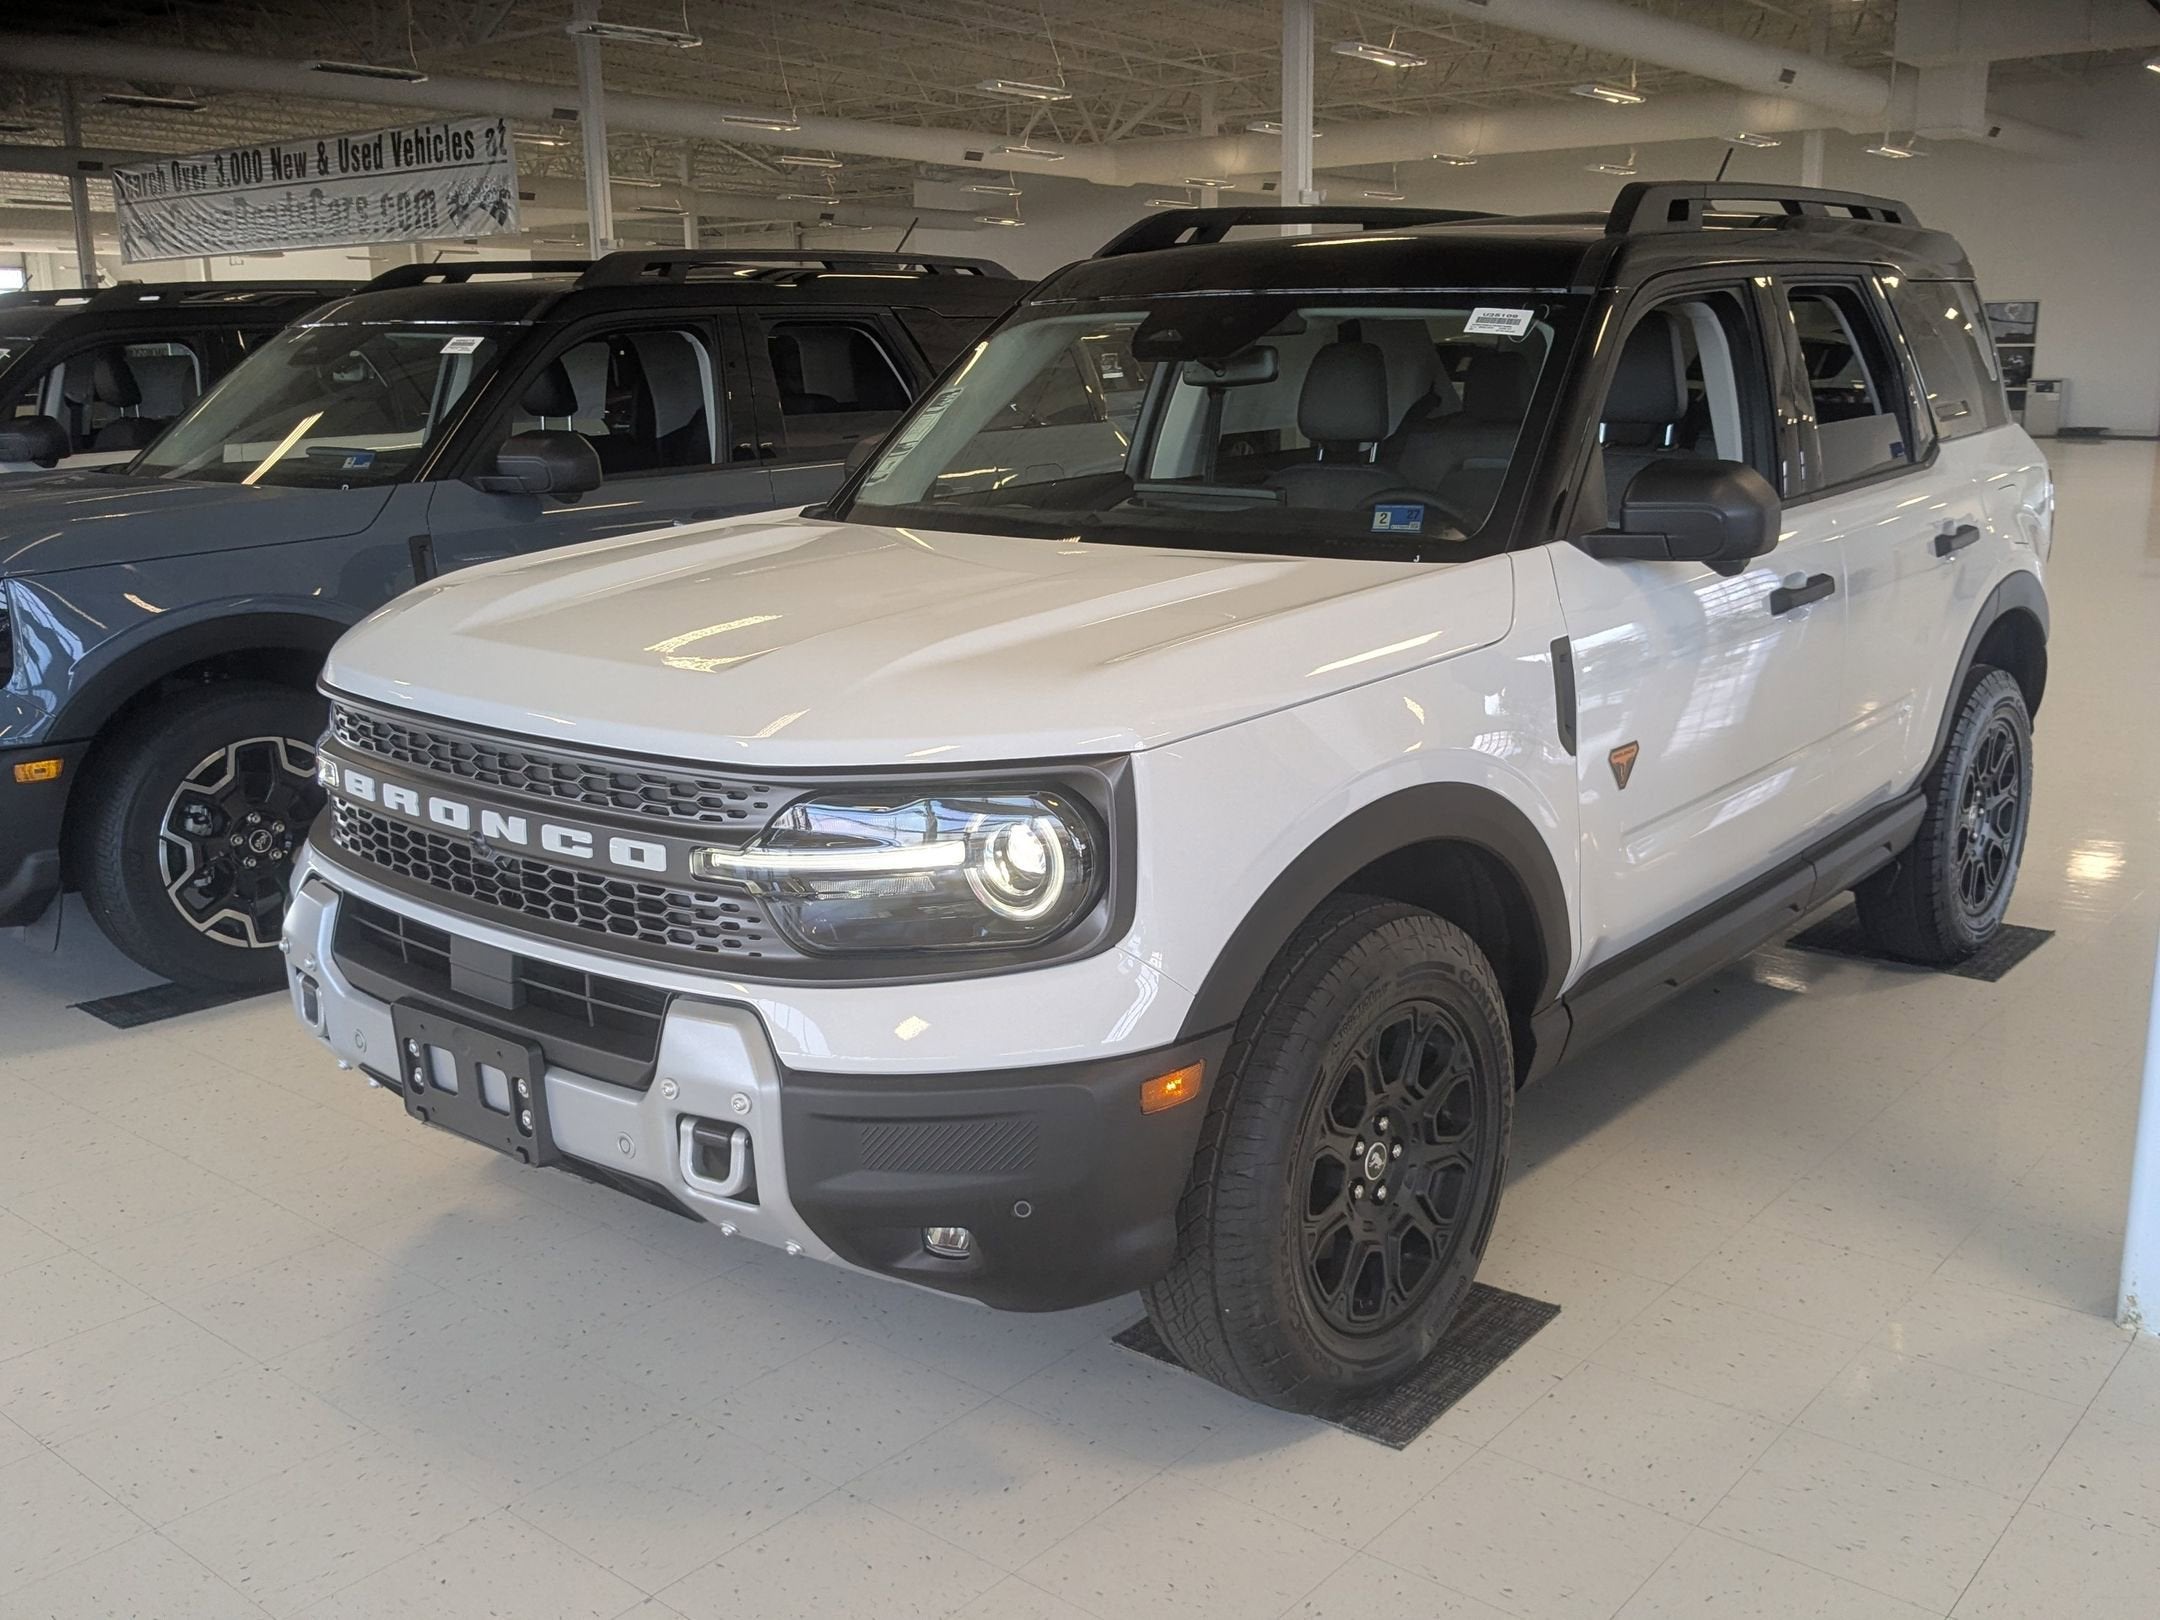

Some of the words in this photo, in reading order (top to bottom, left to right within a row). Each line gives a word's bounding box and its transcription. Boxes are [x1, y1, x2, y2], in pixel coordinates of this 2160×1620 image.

[171, 160, 207, 192] Over
[270, 146, 307, 181] New
[316, 141, 329, 176] &
[338, 134, 384, 173] Used
[391, 124, 475, 168] Vehicles
[485, 118, 507, 158] at
[1379, 512, 1388, 525] 2
[343, 768, 667, 872] BRONCO
